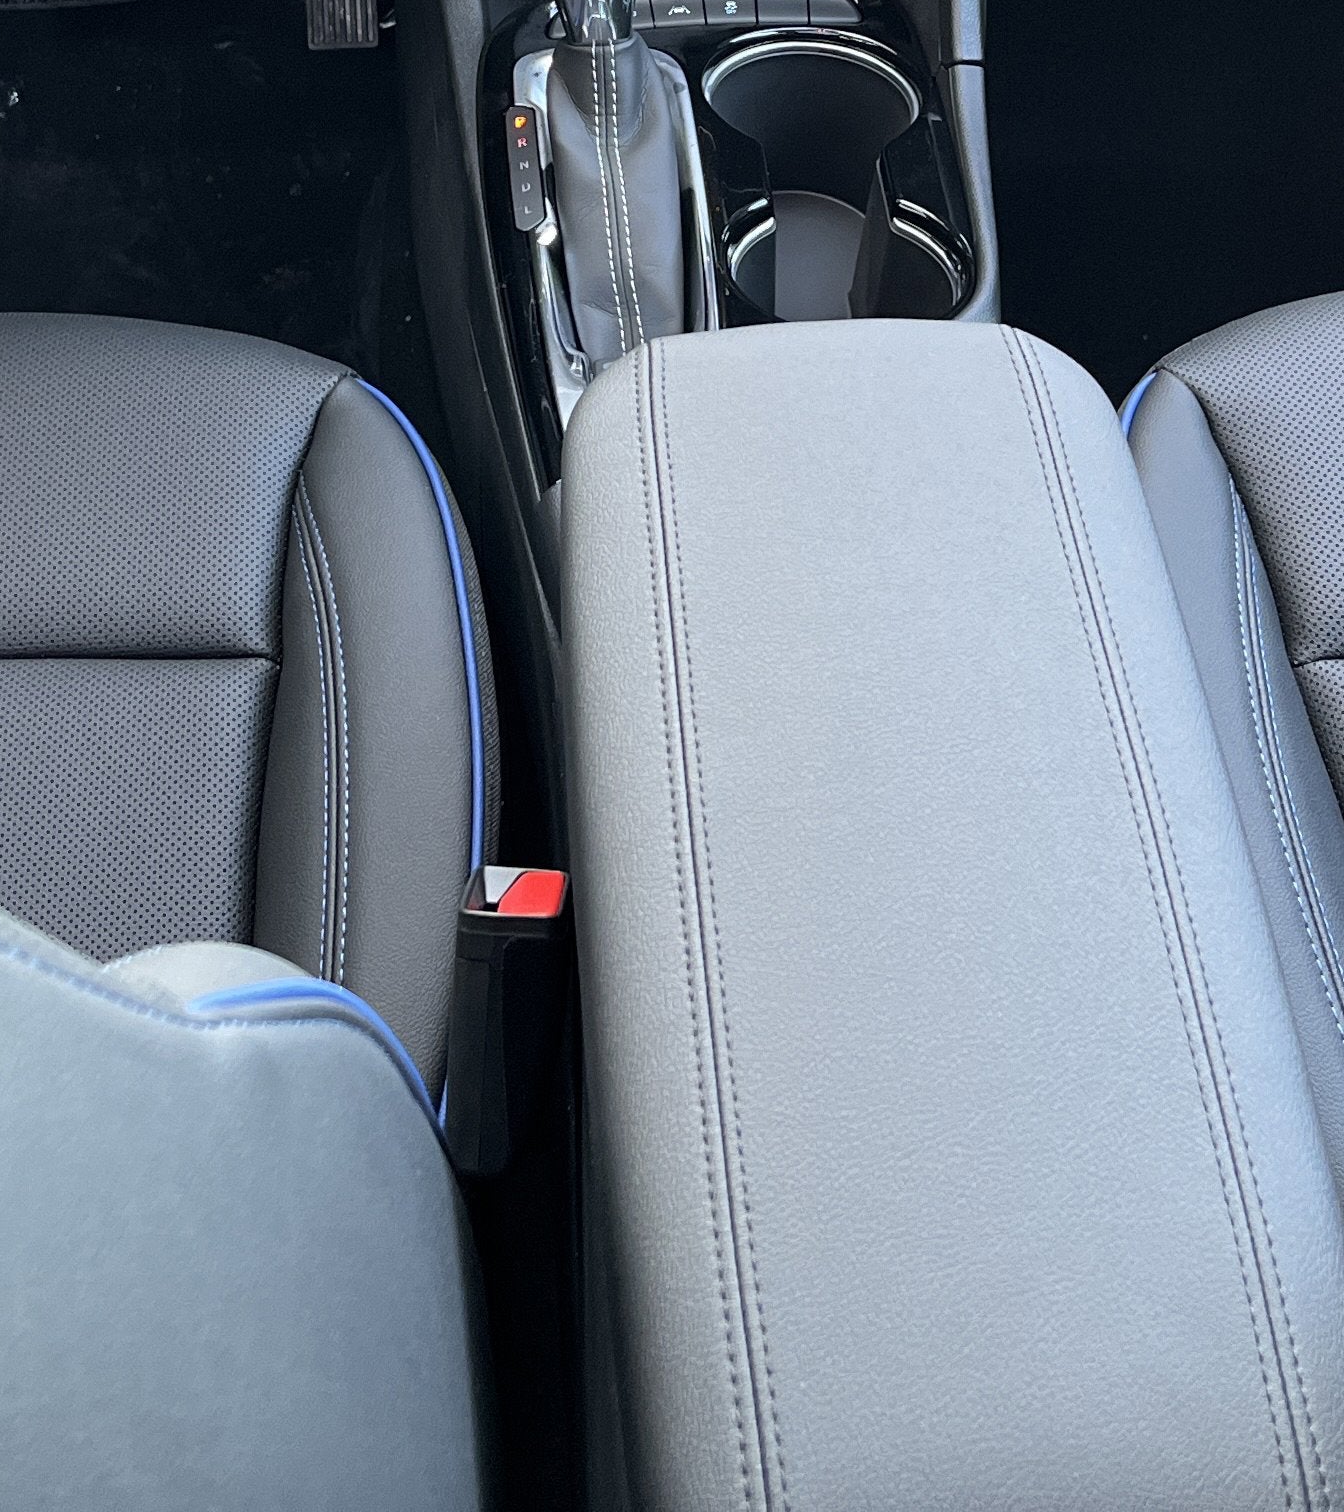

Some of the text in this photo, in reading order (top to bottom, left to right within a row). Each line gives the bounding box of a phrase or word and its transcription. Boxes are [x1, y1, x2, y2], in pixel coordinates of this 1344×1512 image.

[514, 116, 527, 128] P
[517, 137, 528, 148] R
[519, 160, 529, 170] N
[524, 206, 532, 214] L
